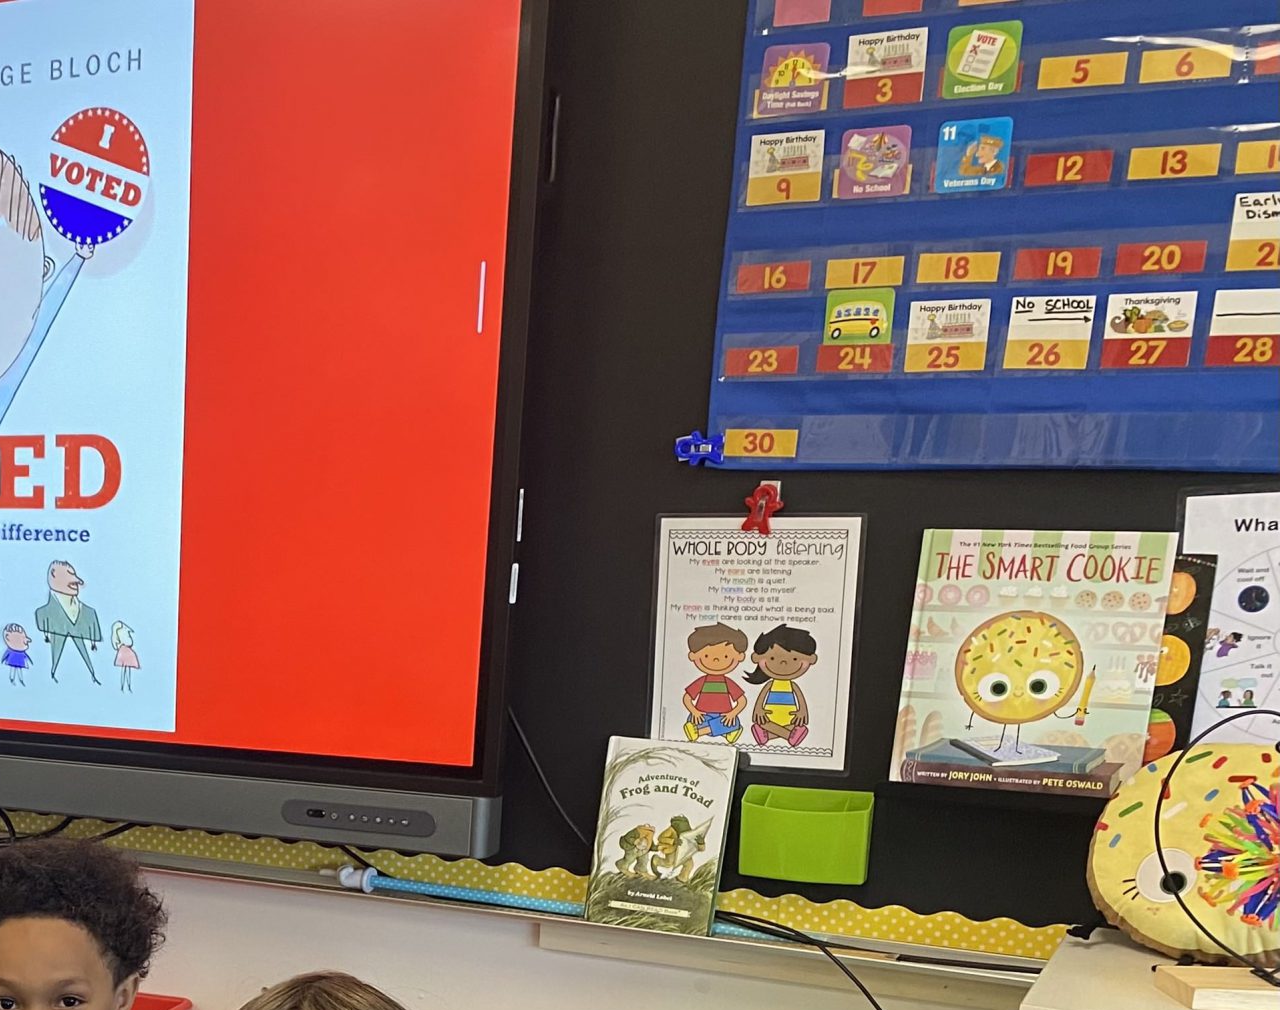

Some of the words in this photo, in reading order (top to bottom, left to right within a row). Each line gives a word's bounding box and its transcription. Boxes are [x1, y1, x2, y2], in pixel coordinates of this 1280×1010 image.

[858, 37, 885, 46] Happy
[886, 32, 921, 43] Birthday
[976, 34, 998, 46] VOTE
[50, 48, 142, 81] BLOCH
[1071, 59, 1090, 84] 5
[1175, 52, 1194, 77] 6
[875, 78, 893, 102] 3
[954, 82, 985, 94] Election
[987, 81, 1005, 92] Day
[98, 124, 116, 149] I
[759, 136, 784, 147] Happy
[785, 134, 817, 145] Birthday
[942, 126, 956, 141] 11
[1056, 155, 1083, 182] 12
[1160, 150, 1188, 176] 13
[49, 152, 142, 207] VOTED
[776, 178, 791, 200] 9
[853, 185, 864, 194] No
[865, 183, 891, 193] School
[943, 178, 980, 188] Veterans
[981, 177, 996, 188] Day
[944, 256, 969, 280] 18
[1046, 251, 1072, 276] 19
[1141, 245, 1181, 271] 20
[764, 266, 786, 289] 16
[852, 261, 877, 284] 17
[920, 304, 946, 313] Happy
[948, 302, 982, 312] Birthday
[1015, 299, 1035, 310] No
[1045, 298, 1093, 311] SCHOOL
[1124, 296, 1180, 306] Thanksgiving
[838, 347, 871, 370] 24
[927, 346, 960, 368] 25
[1026, 343, 1060, 366] 26
[1128, 340, 1167, 365] 27
[1233, 337, 1273, 362] 28
[748, 350, 777, 372] 23
[743, 432, 774, 454] 30
[673, 541, 721, 555] WHOLE
[727, 541, 767, 555] BODY
[777, 540, 844, 560] listening
[1033, 542, 1068, 550] Bestselling
[690, 558, 700, 566] My
[737, 559, 762, 567] looking
[936, 552, 975, 580] THE
[982, 551, 1060, 582] SMART
[1066, 553, 1161, 584] COOKIE
[638, 774, 687, 784] Adventures
[948, 771, 969, 780] JORY
[970, 773, 992, 782] JOHN
[1042, 778, 1063, 787] PETE
[1066, 780, 1103, 790] OSWALD
[619, 783, 651, 799] Frog
[654, 784, 678, 794] and
[683, 785, 714, 808] Toad
